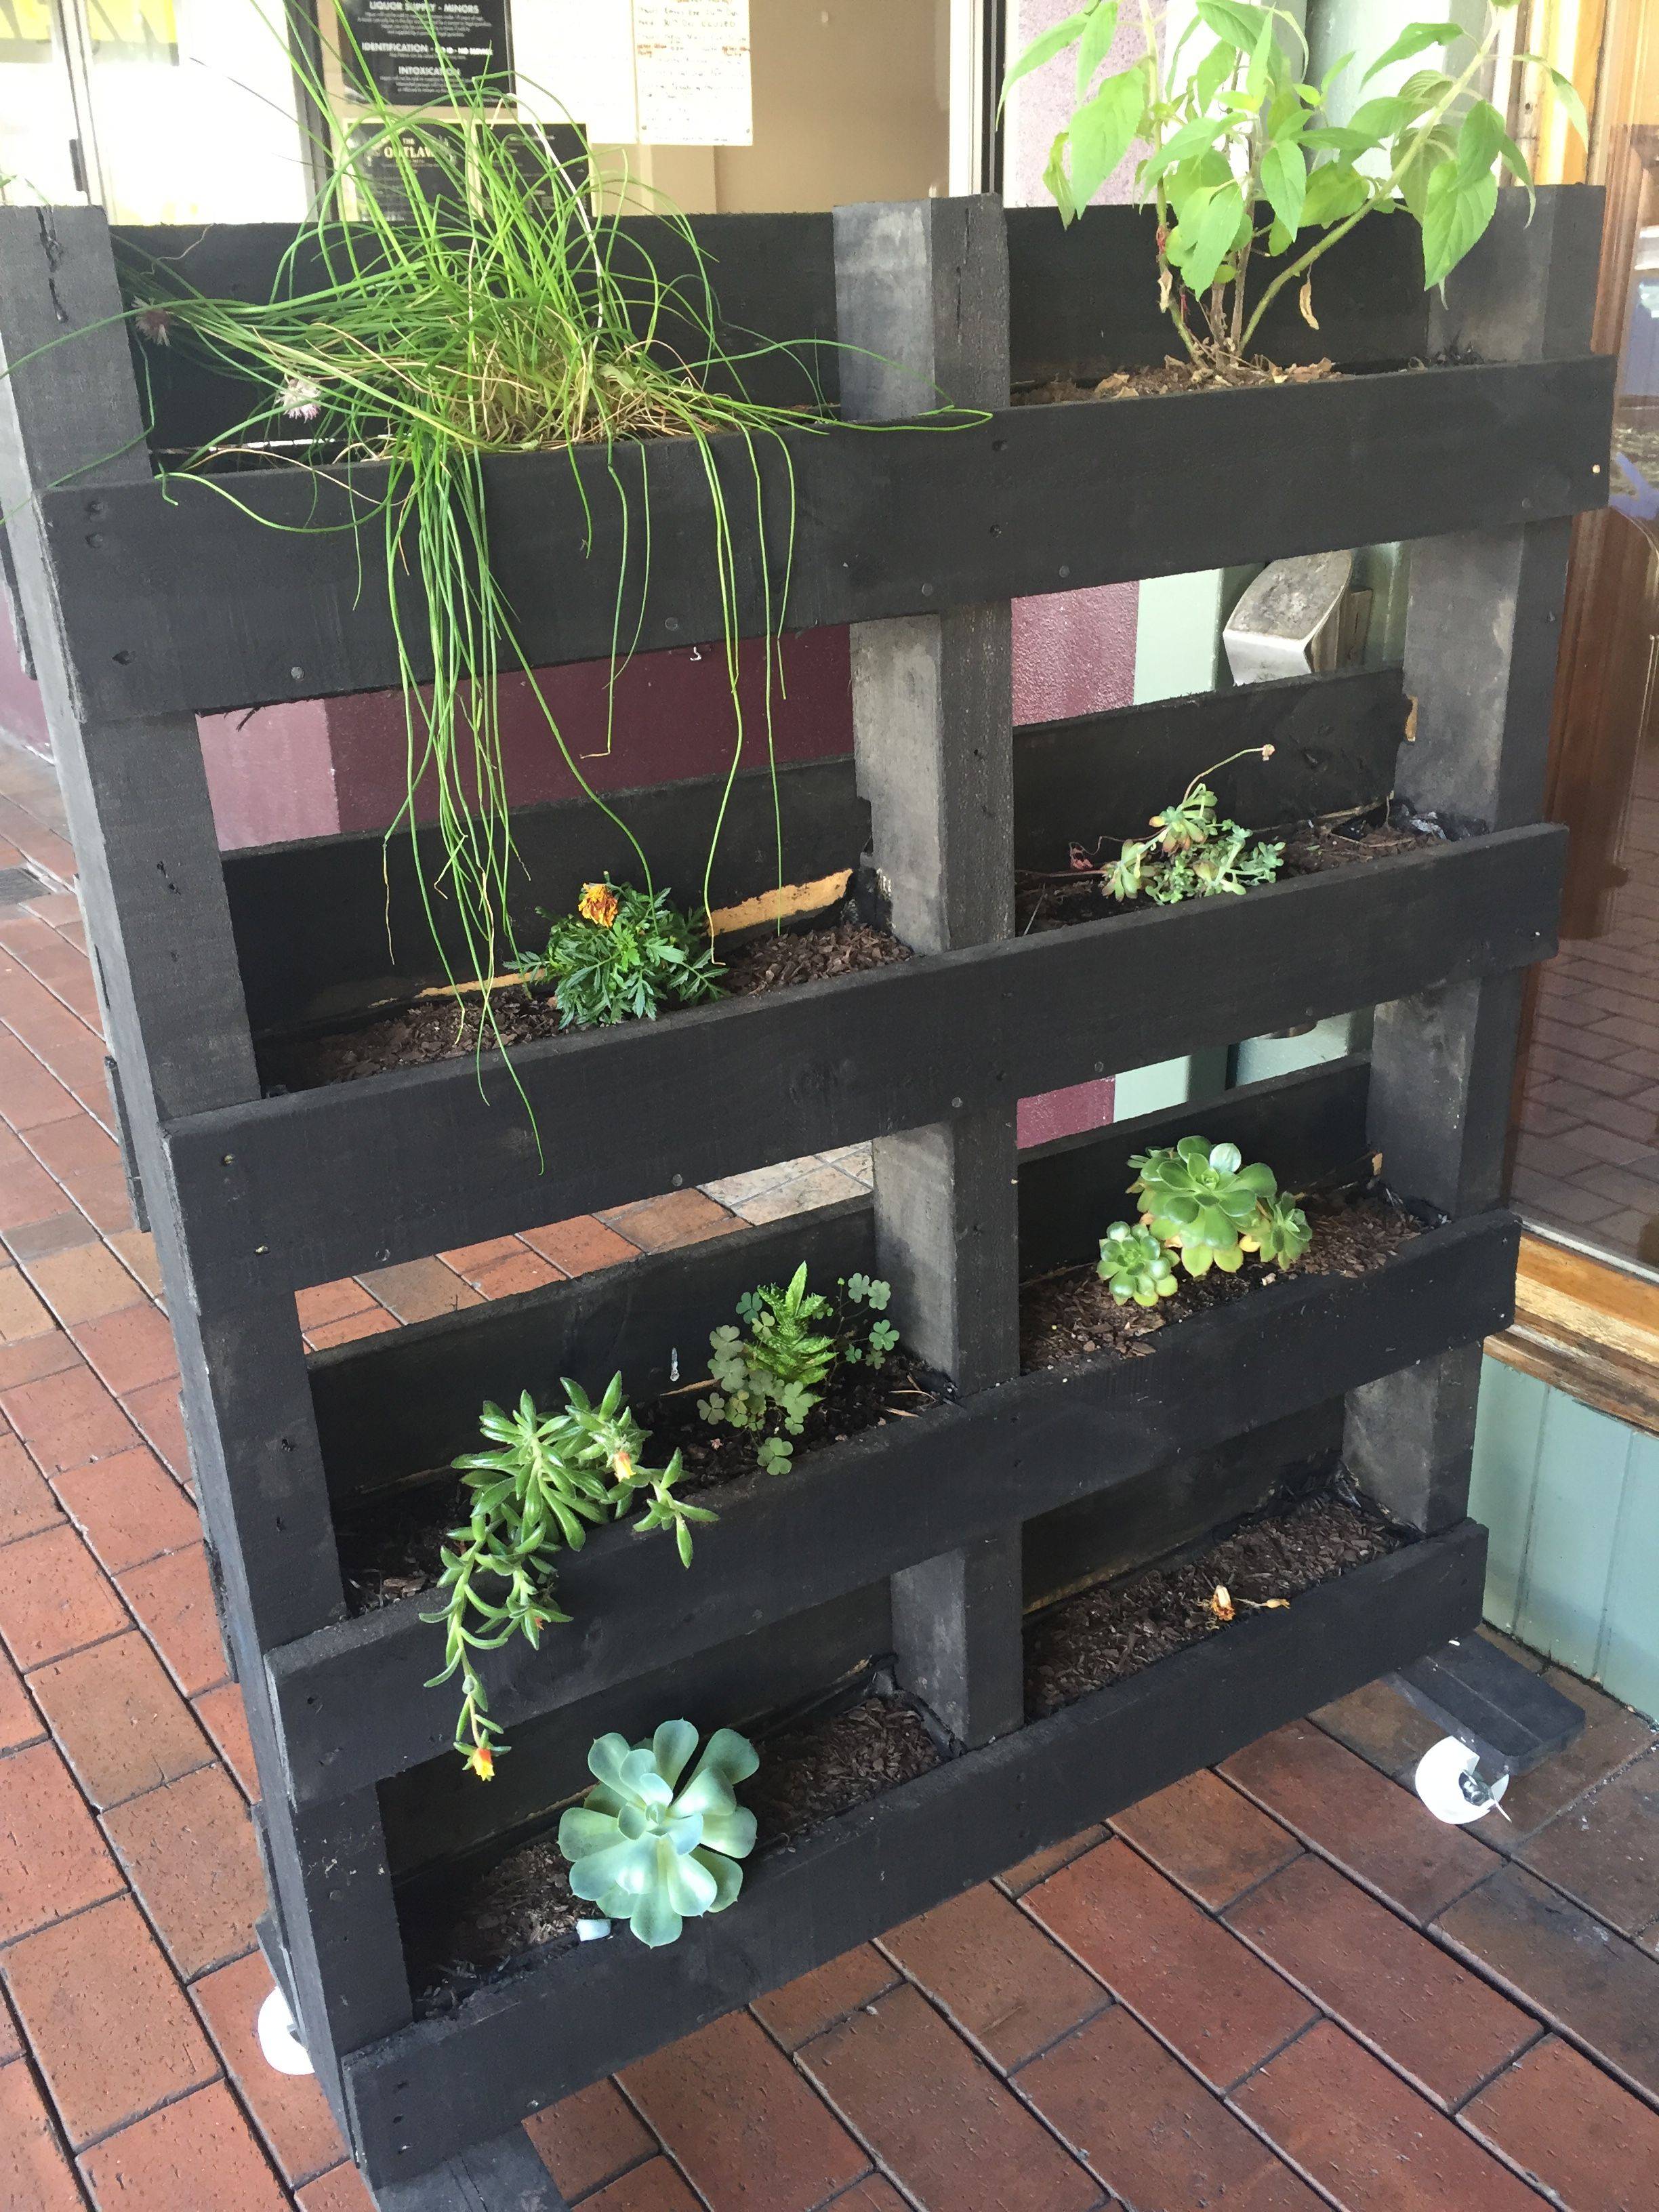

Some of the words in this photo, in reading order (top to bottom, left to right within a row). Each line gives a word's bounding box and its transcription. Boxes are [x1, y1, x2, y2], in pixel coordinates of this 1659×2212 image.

[369, 1, 403, 10] LIQUOR
[405, 2, 436, 12] SUPPY
[444, 3, 479, 14] MINORS
[362, 42, 428, 53] IDENTIFICATION
[398, 66, 460, 77] INTOXICATON
[384, 146, 436, 159] OTLAW
